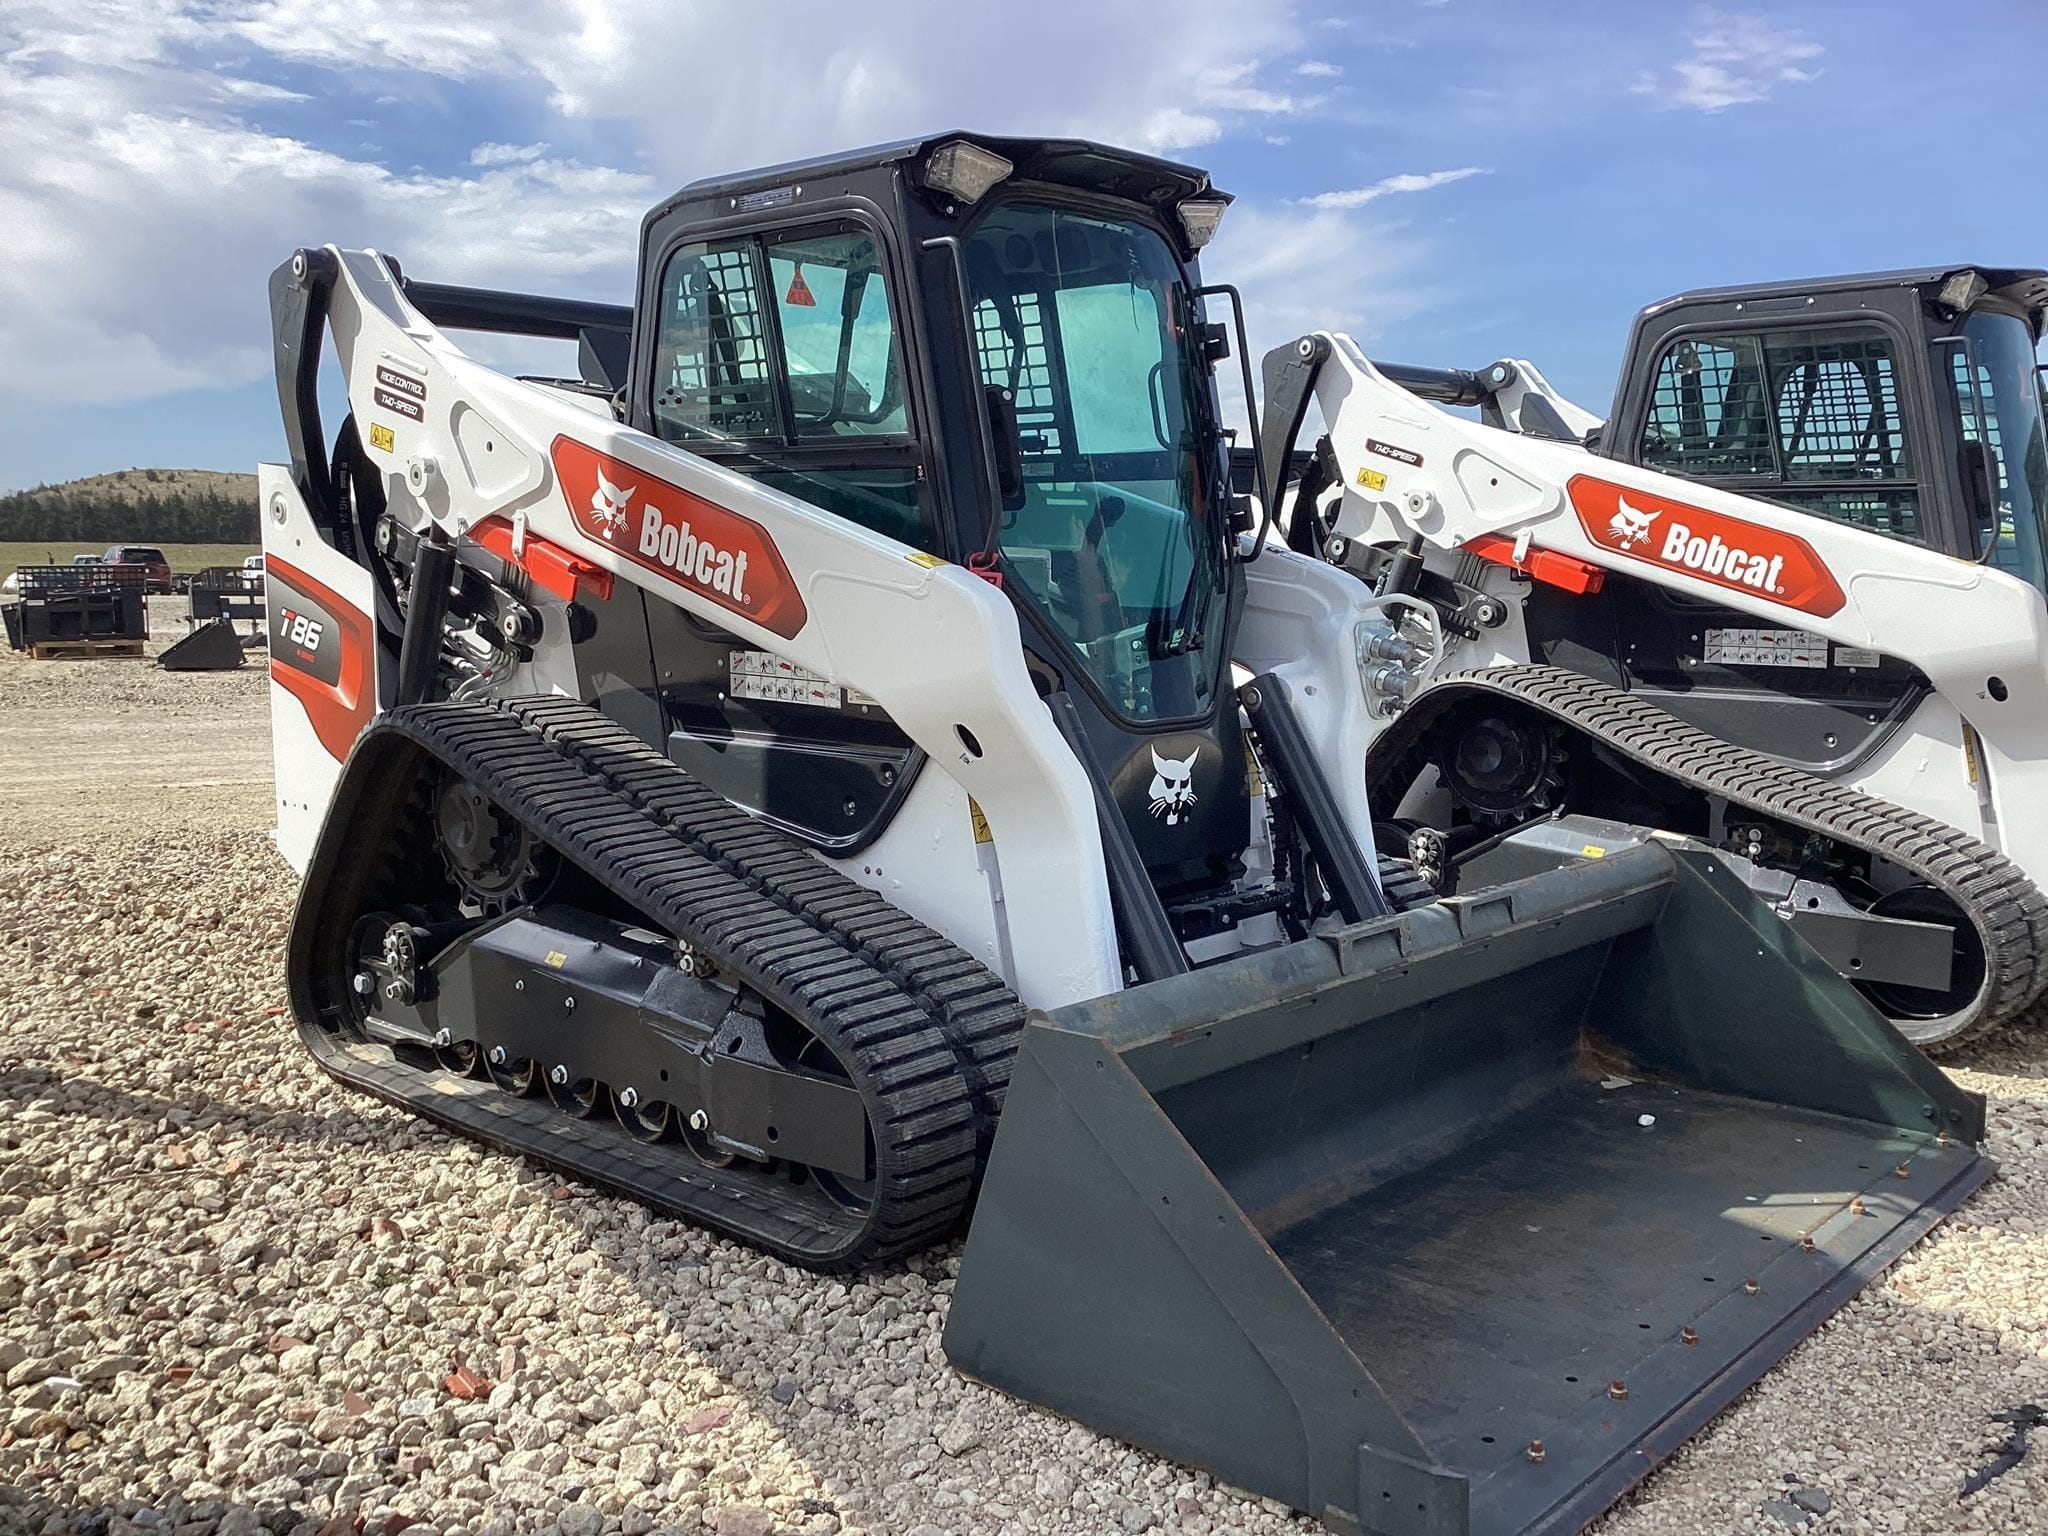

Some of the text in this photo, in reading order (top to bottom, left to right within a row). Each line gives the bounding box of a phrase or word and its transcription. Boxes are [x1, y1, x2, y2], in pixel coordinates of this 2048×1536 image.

[394, 376, 423, 396] CONTROL
[382, 394, 418, 415] TWO-SPEED
[1374, 443, 1417, 463] TWO-SPEED
[639, 503, 747, 602] Bobcat
[1660, 522, 1783, 592] Bobcat
[280, 608, 323, 651] T86
